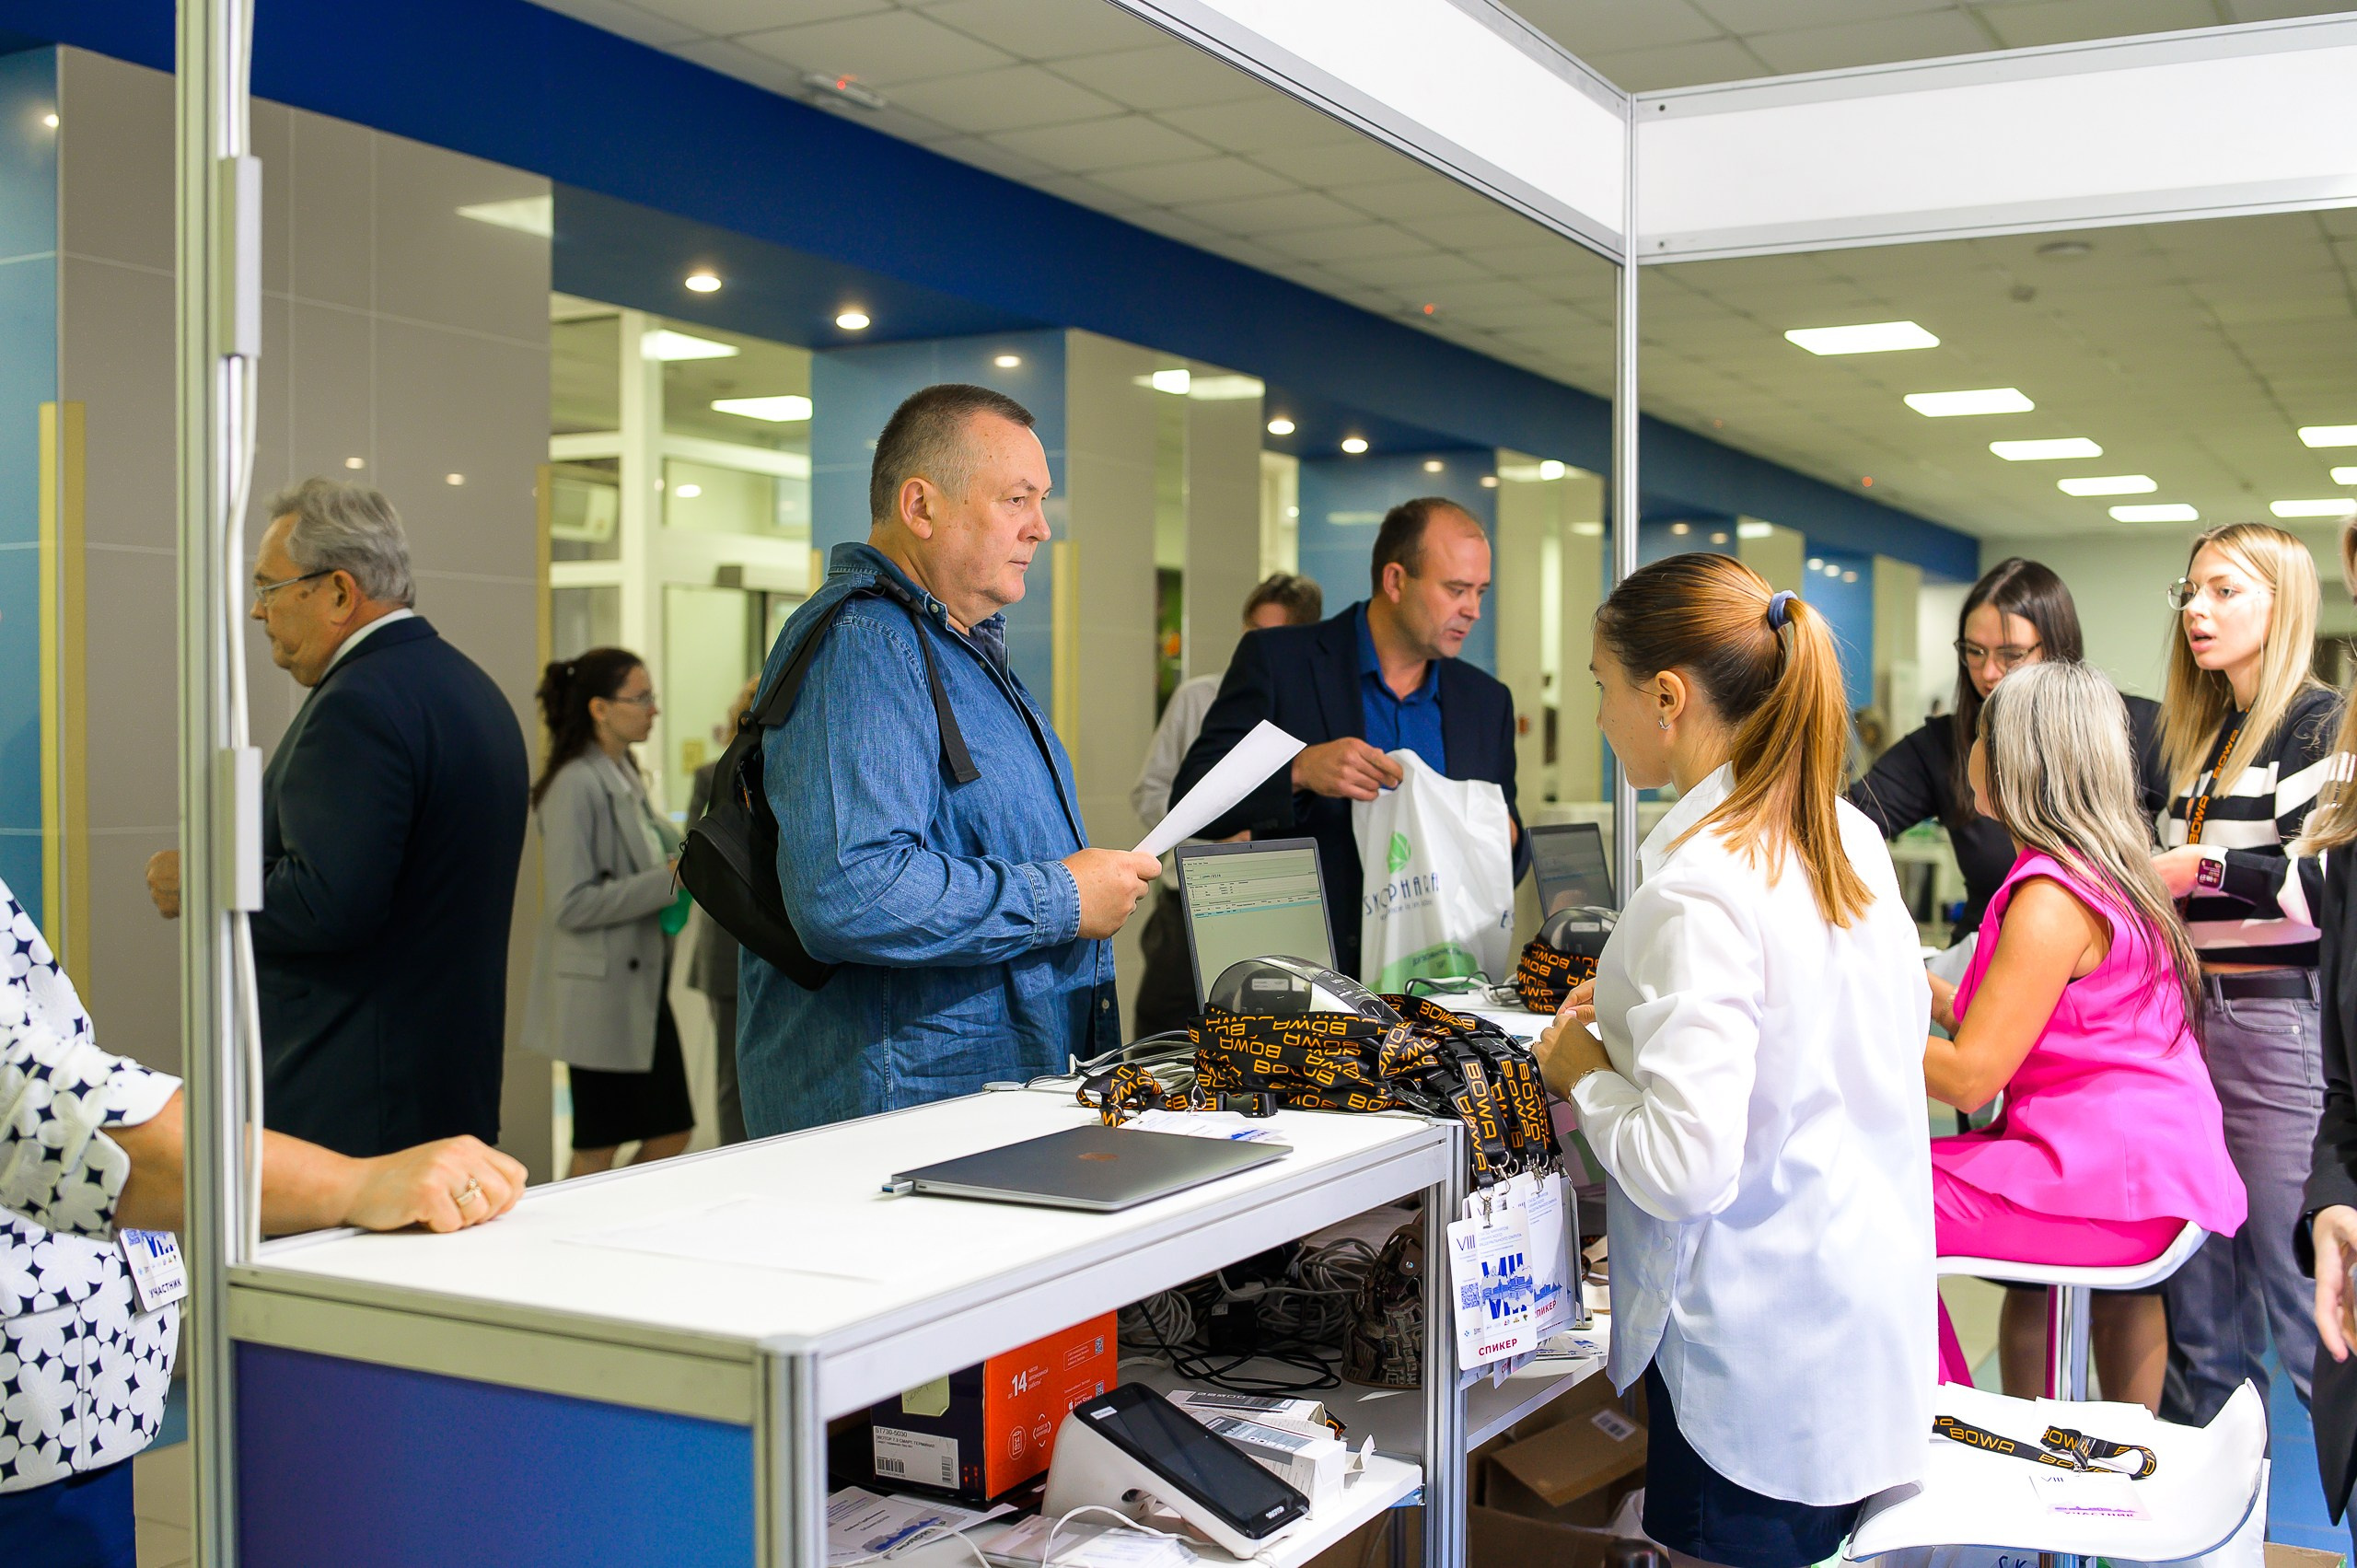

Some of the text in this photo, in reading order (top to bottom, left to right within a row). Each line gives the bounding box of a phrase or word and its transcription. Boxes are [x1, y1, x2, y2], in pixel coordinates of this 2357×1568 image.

[2212, 728, 2239, 780] BOWA
[2189, 795, 2210, 844] BOWA
[1419, 1001, 1463, 1027] BOWA
[1272, 1019, 1348, 1036] BOWA
[1219, 1036, 1283, 1060] BOWA
[1465, 1063, 1498, 1140] BOWA
[1501, 1060, 1530, 1137] BOWA
[1518, 1063, 1541, 1141] BOWA
[1457, 1234, 1476, 1251] VIII
[149, 1278, 182, 1299] УЧАСТНИК
[1535, 1299, 1558, 1318] ПИКЕР
[1479, 1338, 1518, 1356] СПИКЕР
[1011, 1370, 1028, 1397] 14
[1949, 1427, 2015, 1454] BOWA
